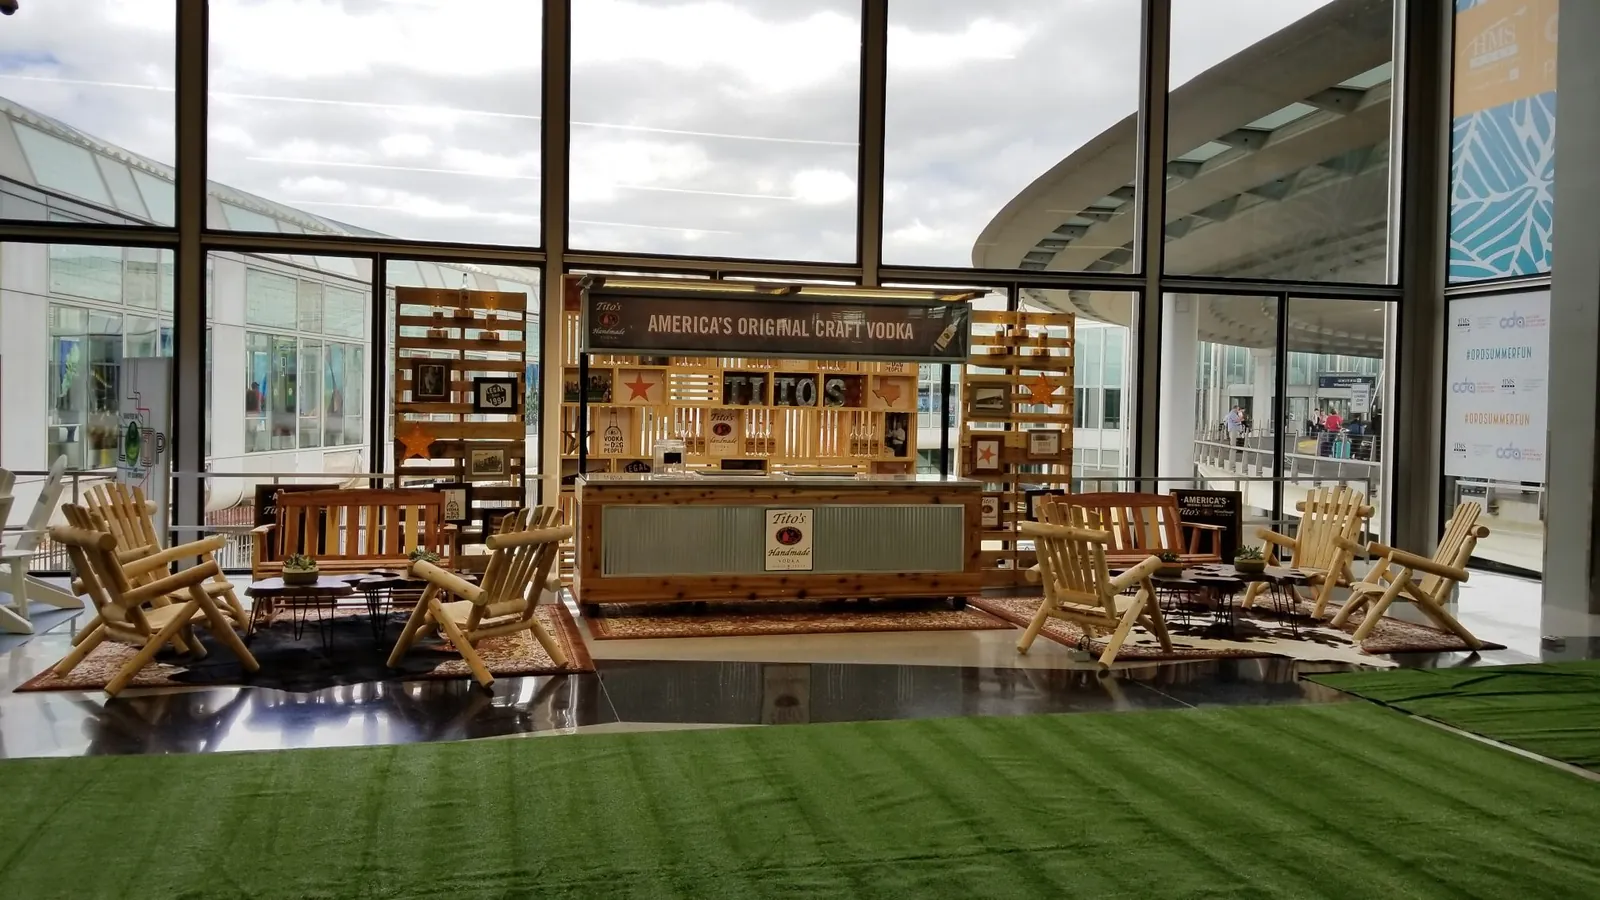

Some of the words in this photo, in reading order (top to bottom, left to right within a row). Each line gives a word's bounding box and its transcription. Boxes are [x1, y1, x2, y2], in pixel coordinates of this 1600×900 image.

[596, 302, 622, 311] Tito's
[647, 314, 733, 335] AMERICA'S
[738, 317, 810, 337] ORIGINAL
[815, 319, 861, 339] CRAFT
[866, 321, 914, 340] VODKA
[1466, 346, 1532, 360] #ORDSUMMERFUN
[724, 376, 847, 407] TITOS
[711, 413, 735, 421] Tito's
[1183, 496, 1227, 505] AMERICA'S
[1179, 507, 1200, 516] Tito's
[772, 512, 807, 525] Tito's
[767, 547, 811, 557] Handmade
